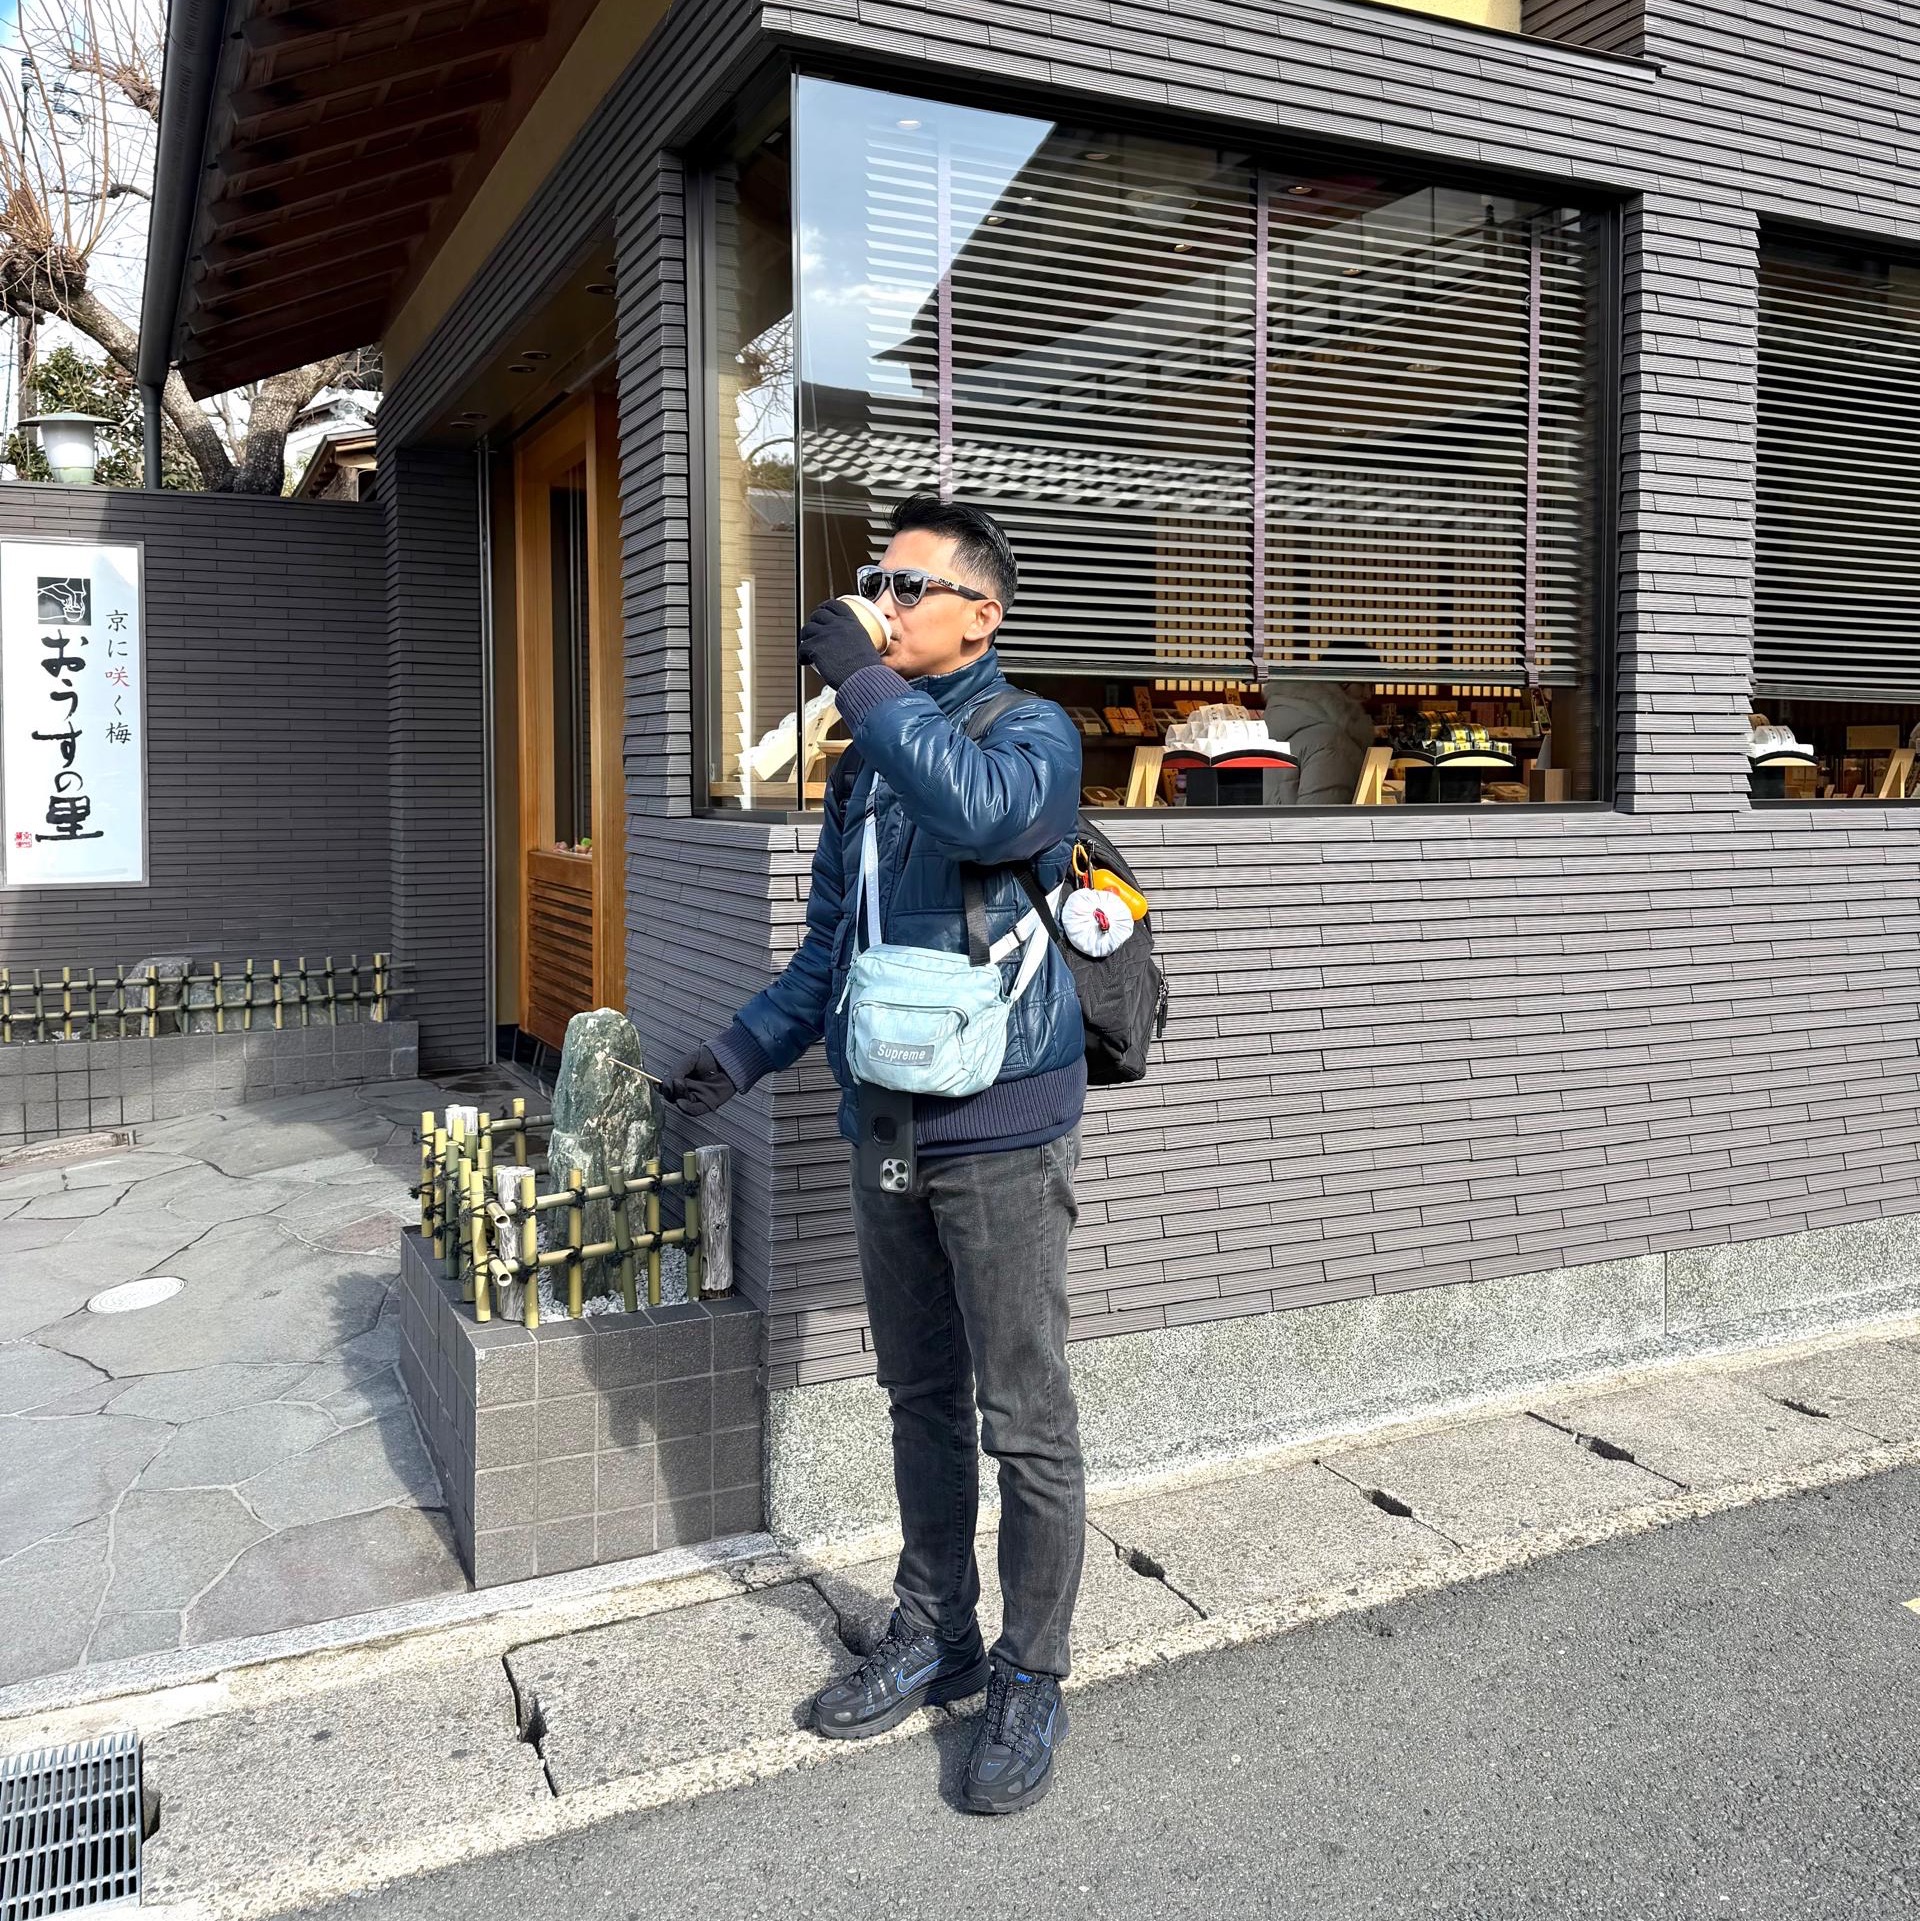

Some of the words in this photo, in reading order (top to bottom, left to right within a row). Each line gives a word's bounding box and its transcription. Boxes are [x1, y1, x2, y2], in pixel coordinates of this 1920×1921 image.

[32, 629, 104, 842] おうすの里
[105, 609, 132, 744] 京に咲く梅
[878, 1044, 925, 1061] Supreme
